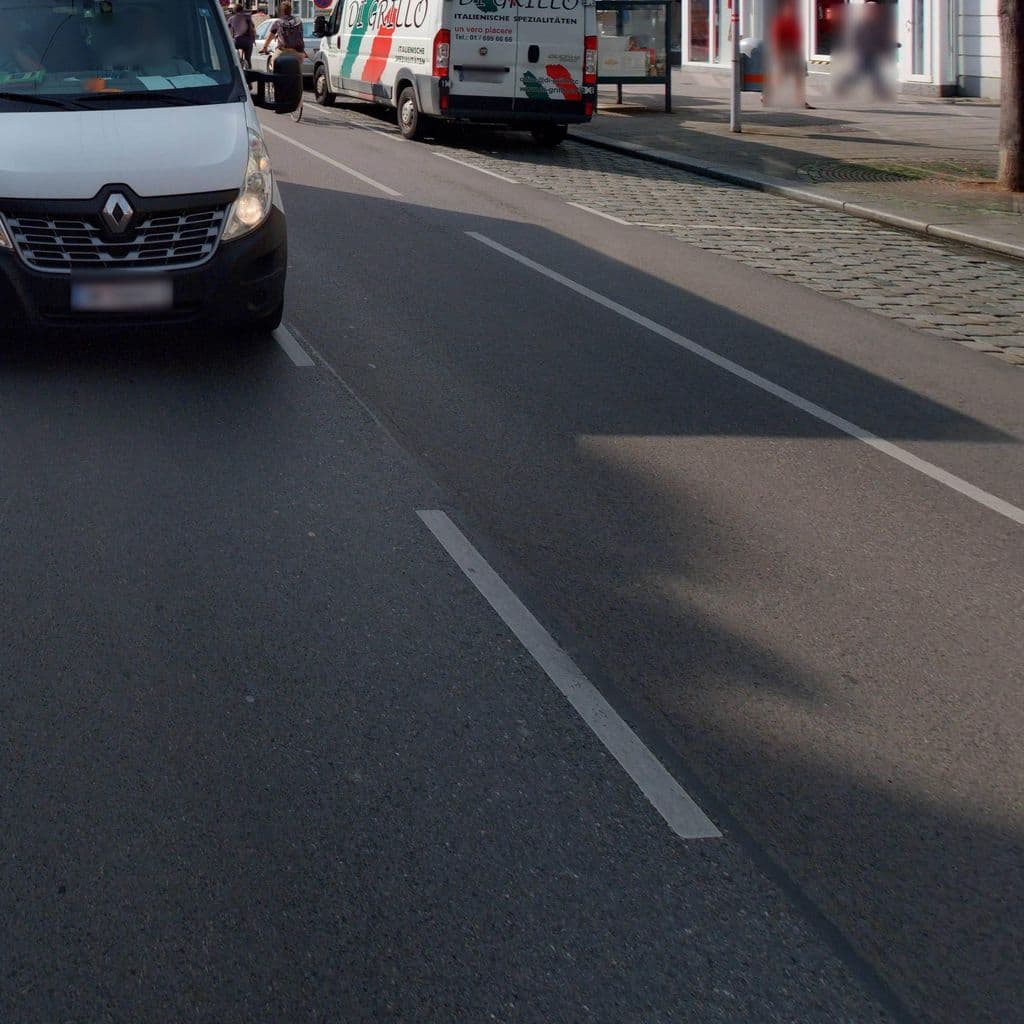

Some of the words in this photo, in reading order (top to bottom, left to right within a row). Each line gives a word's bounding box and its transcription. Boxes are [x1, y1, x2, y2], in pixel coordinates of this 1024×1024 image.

[348, 0, 366, 29] DI
[454, 13, 510, 22] ITALIENISCHE
[513, 15, 577, 25] SPEZIALITÄTEN
[484, 26, 513, 35] piacere
